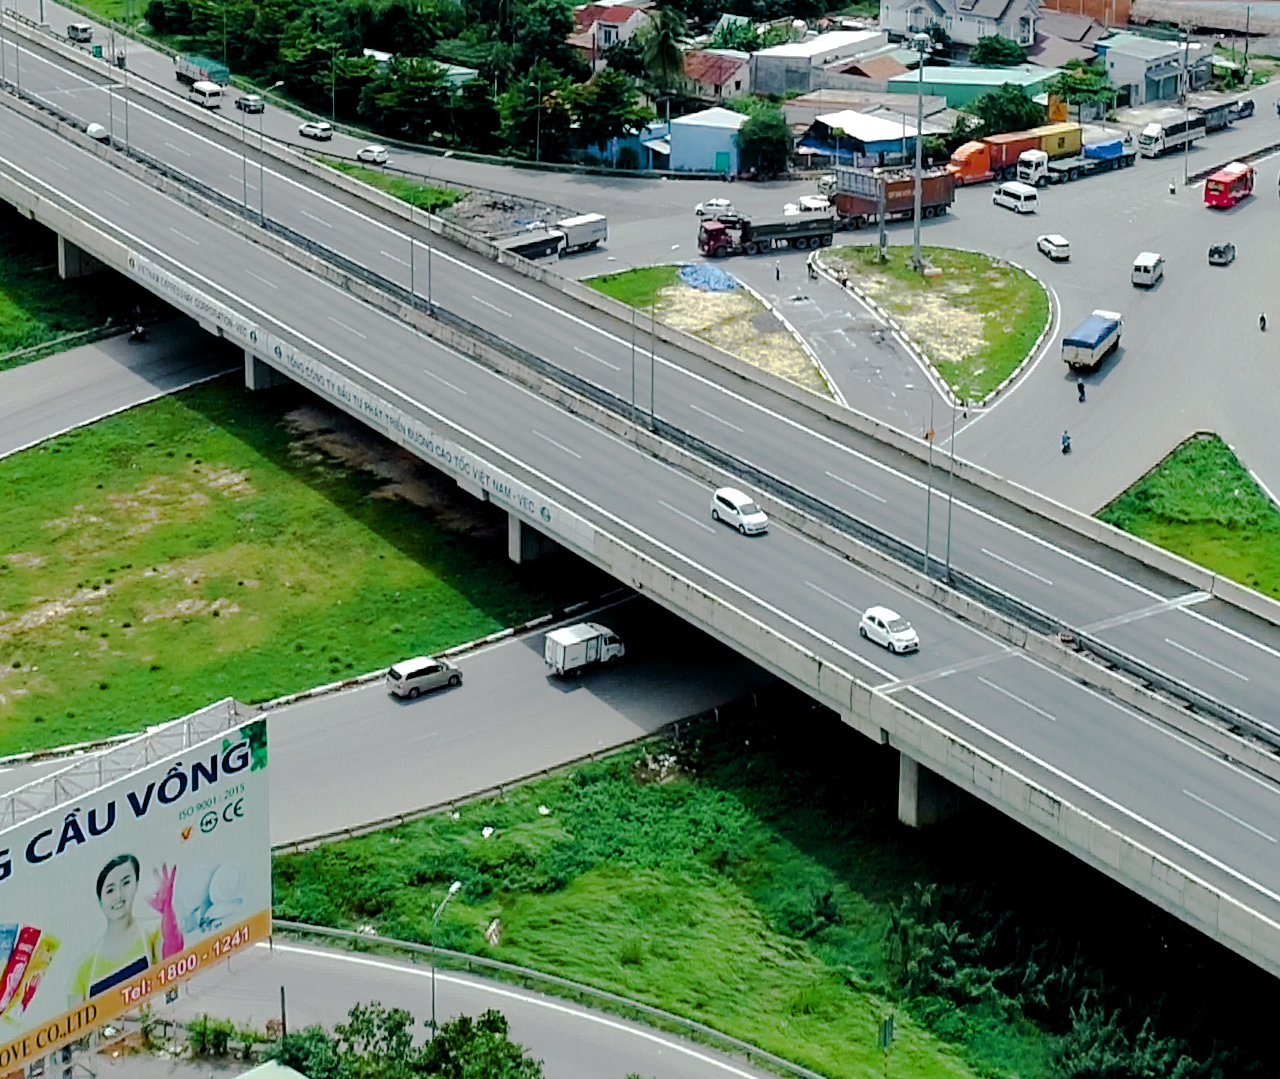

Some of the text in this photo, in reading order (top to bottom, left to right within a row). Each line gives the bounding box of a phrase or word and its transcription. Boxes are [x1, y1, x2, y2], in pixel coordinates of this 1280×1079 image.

[435, 445, 452, 464] CAO
[454, 450, 470, 475] TỐC
[472, 465, 490, 489] VIỆT
[492, 479, 511, 498] NAM
[517, 492, 536, 514] VEC
[25, 799, 117, 864] CẦU
[125, 740, 250, 818] VỒNG
[178, 806, 195, 821] ISO
[224, 782, 245, 800] 2015
[222, 797, 245, 823] CE
[120, 980, 153, 1005] Tel:
[157, 956, 198, 986] 1800
[211, 926, 252, 958] 1241
